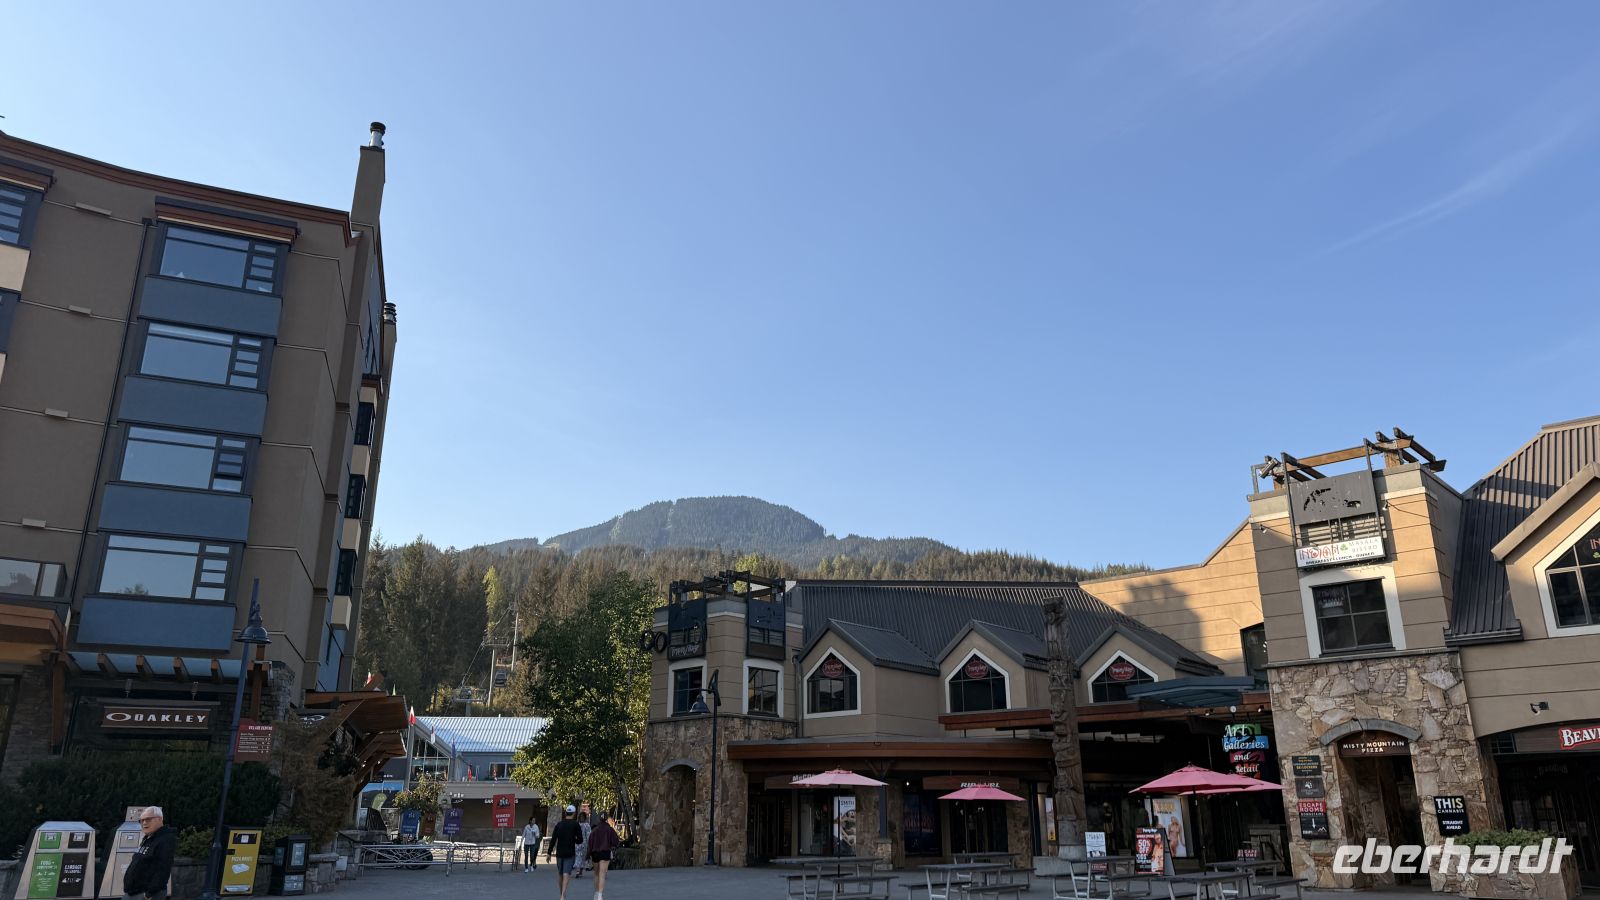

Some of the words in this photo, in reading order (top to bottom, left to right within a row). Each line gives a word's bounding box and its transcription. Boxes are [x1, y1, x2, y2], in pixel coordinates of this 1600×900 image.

[1349, 538, 1379, 548] MASALA
[1299, 544, 1340, 561] INDIAN
[1352, 545, 1378, 554] BISTRO
[134, 713, 206, 723] OAKLEY
[1224, 724, 1248, 738] Art
[1223, 740, 1265, 752] Galleries
[1234, 752, 1251, 761] and
[1435, 798, 1463, 809] THIS
